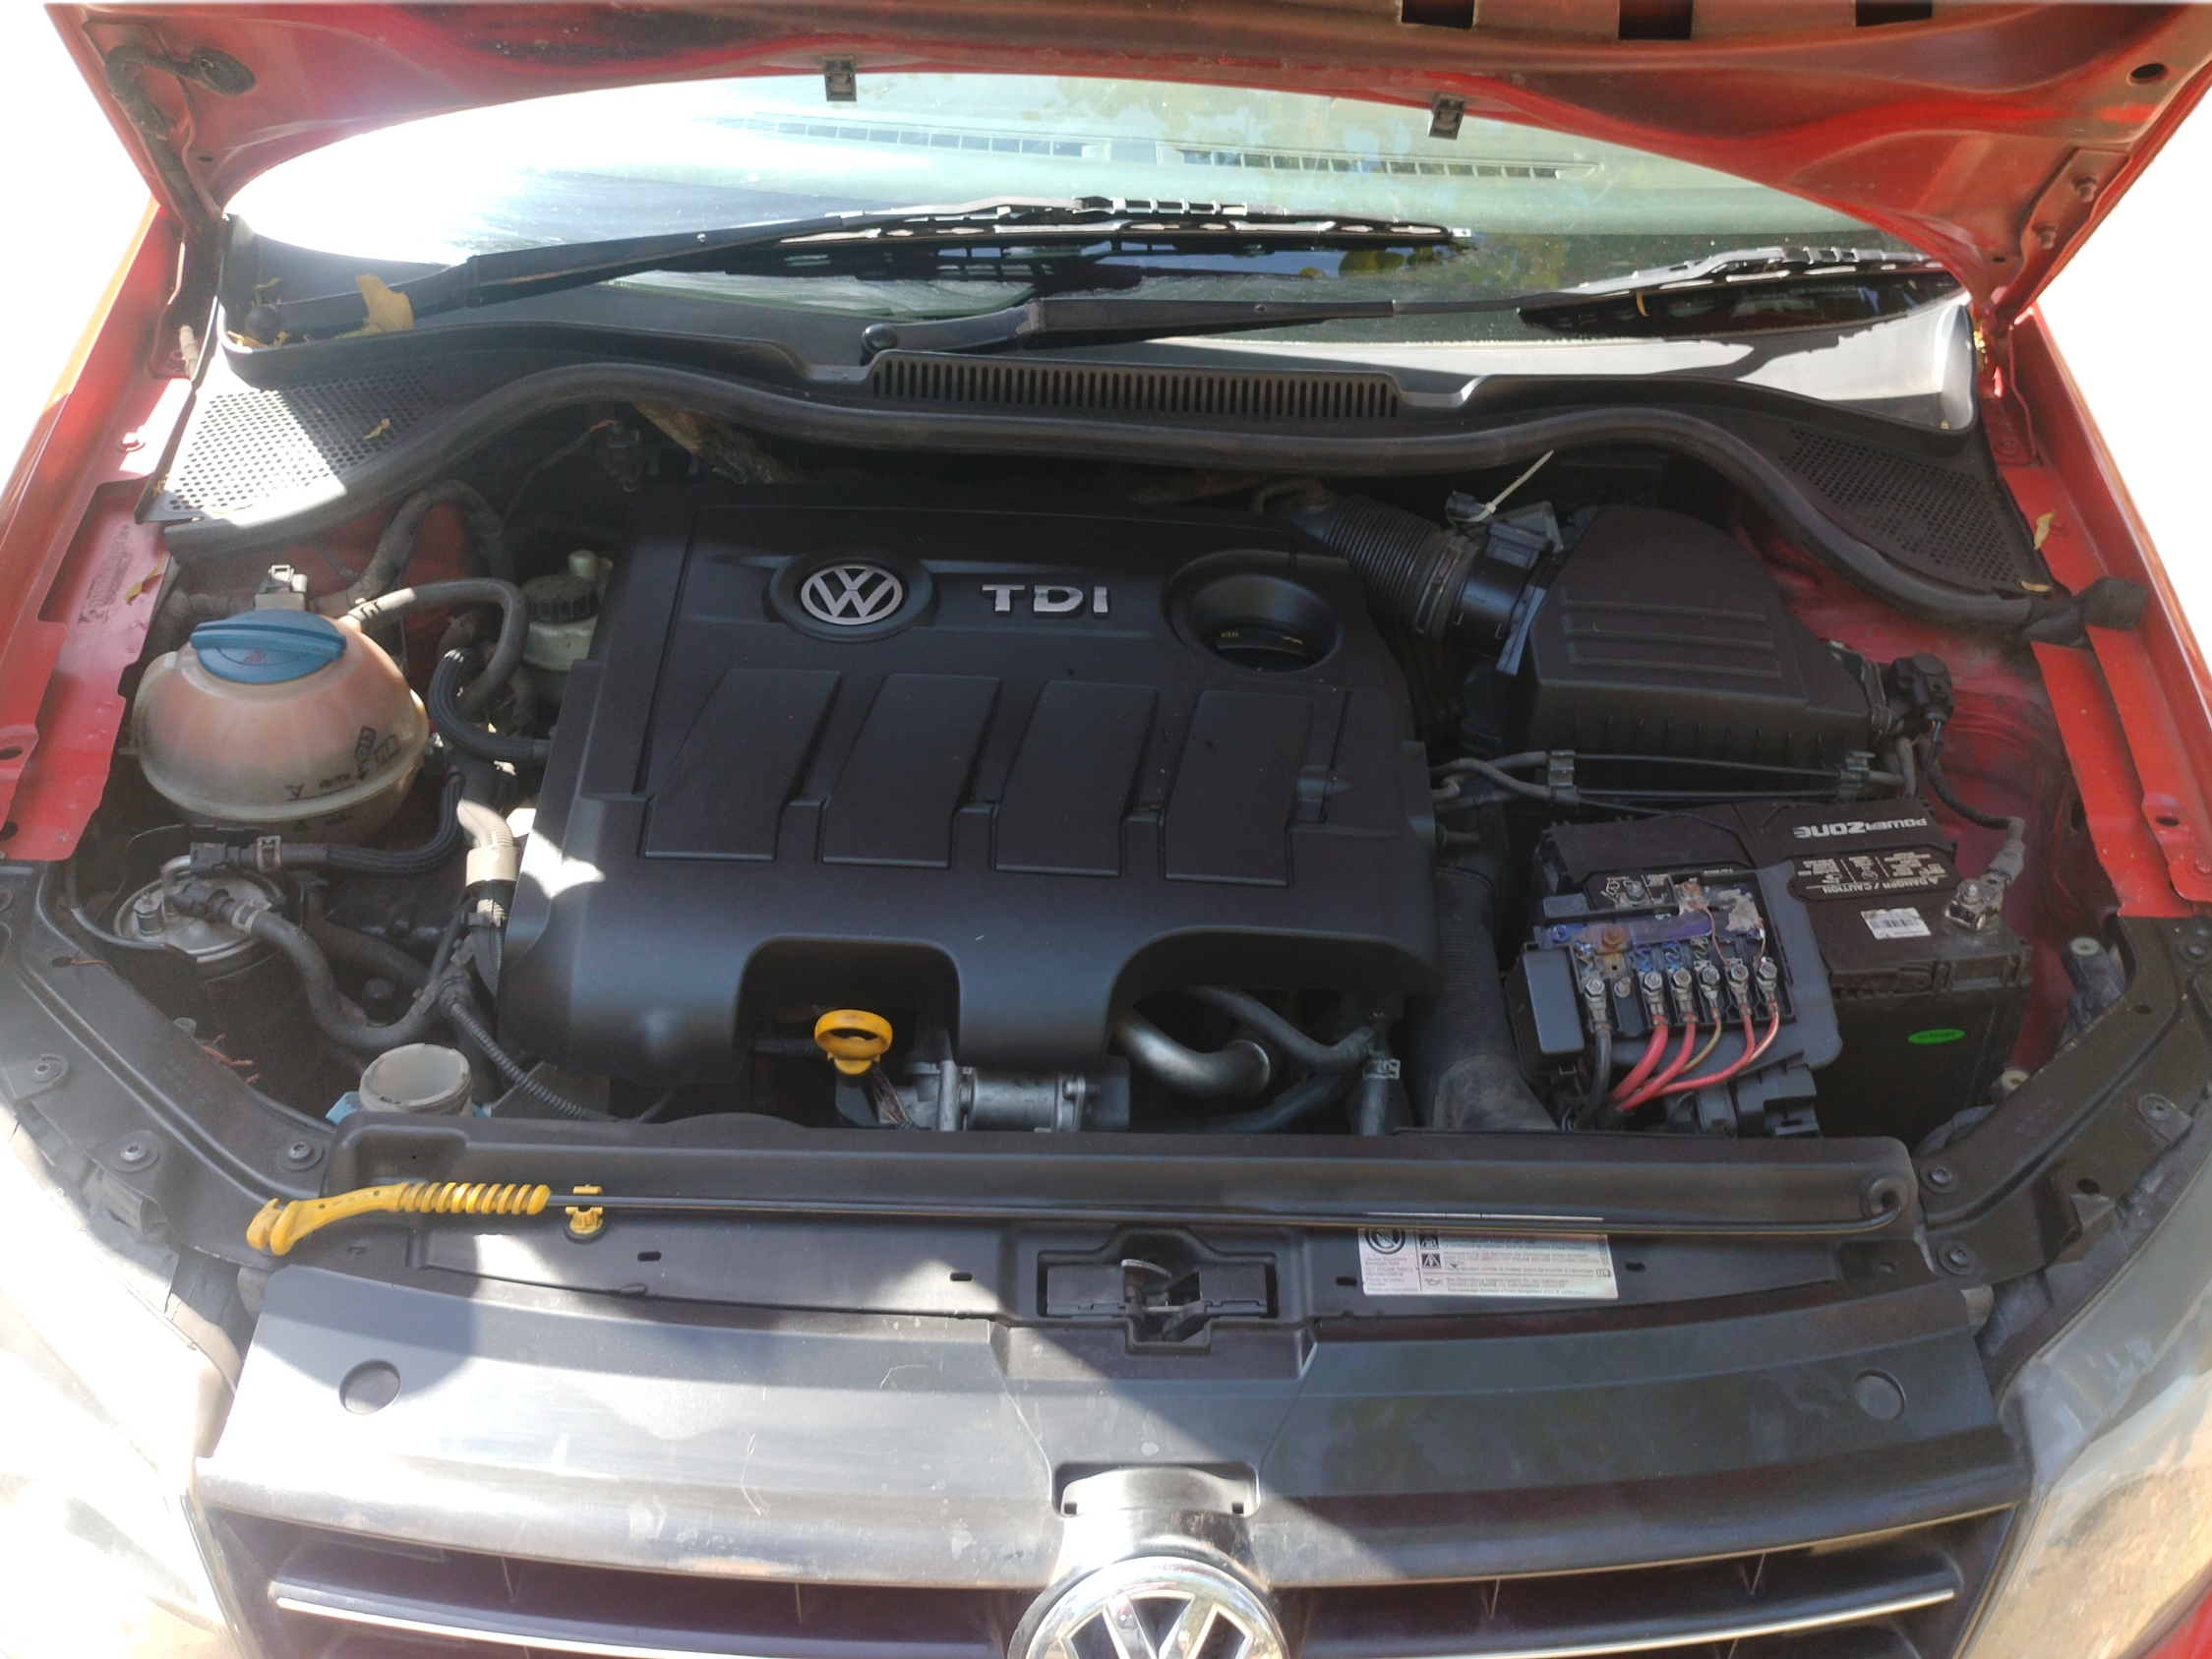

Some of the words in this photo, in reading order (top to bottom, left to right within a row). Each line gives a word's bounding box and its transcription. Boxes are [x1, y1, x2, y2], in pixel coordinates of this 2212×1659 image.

[982, 584, 1109, 614] TDI
[1823, 882, 1873, 895] CAUTION
[1883, 876, 1930, 890] DANGER
